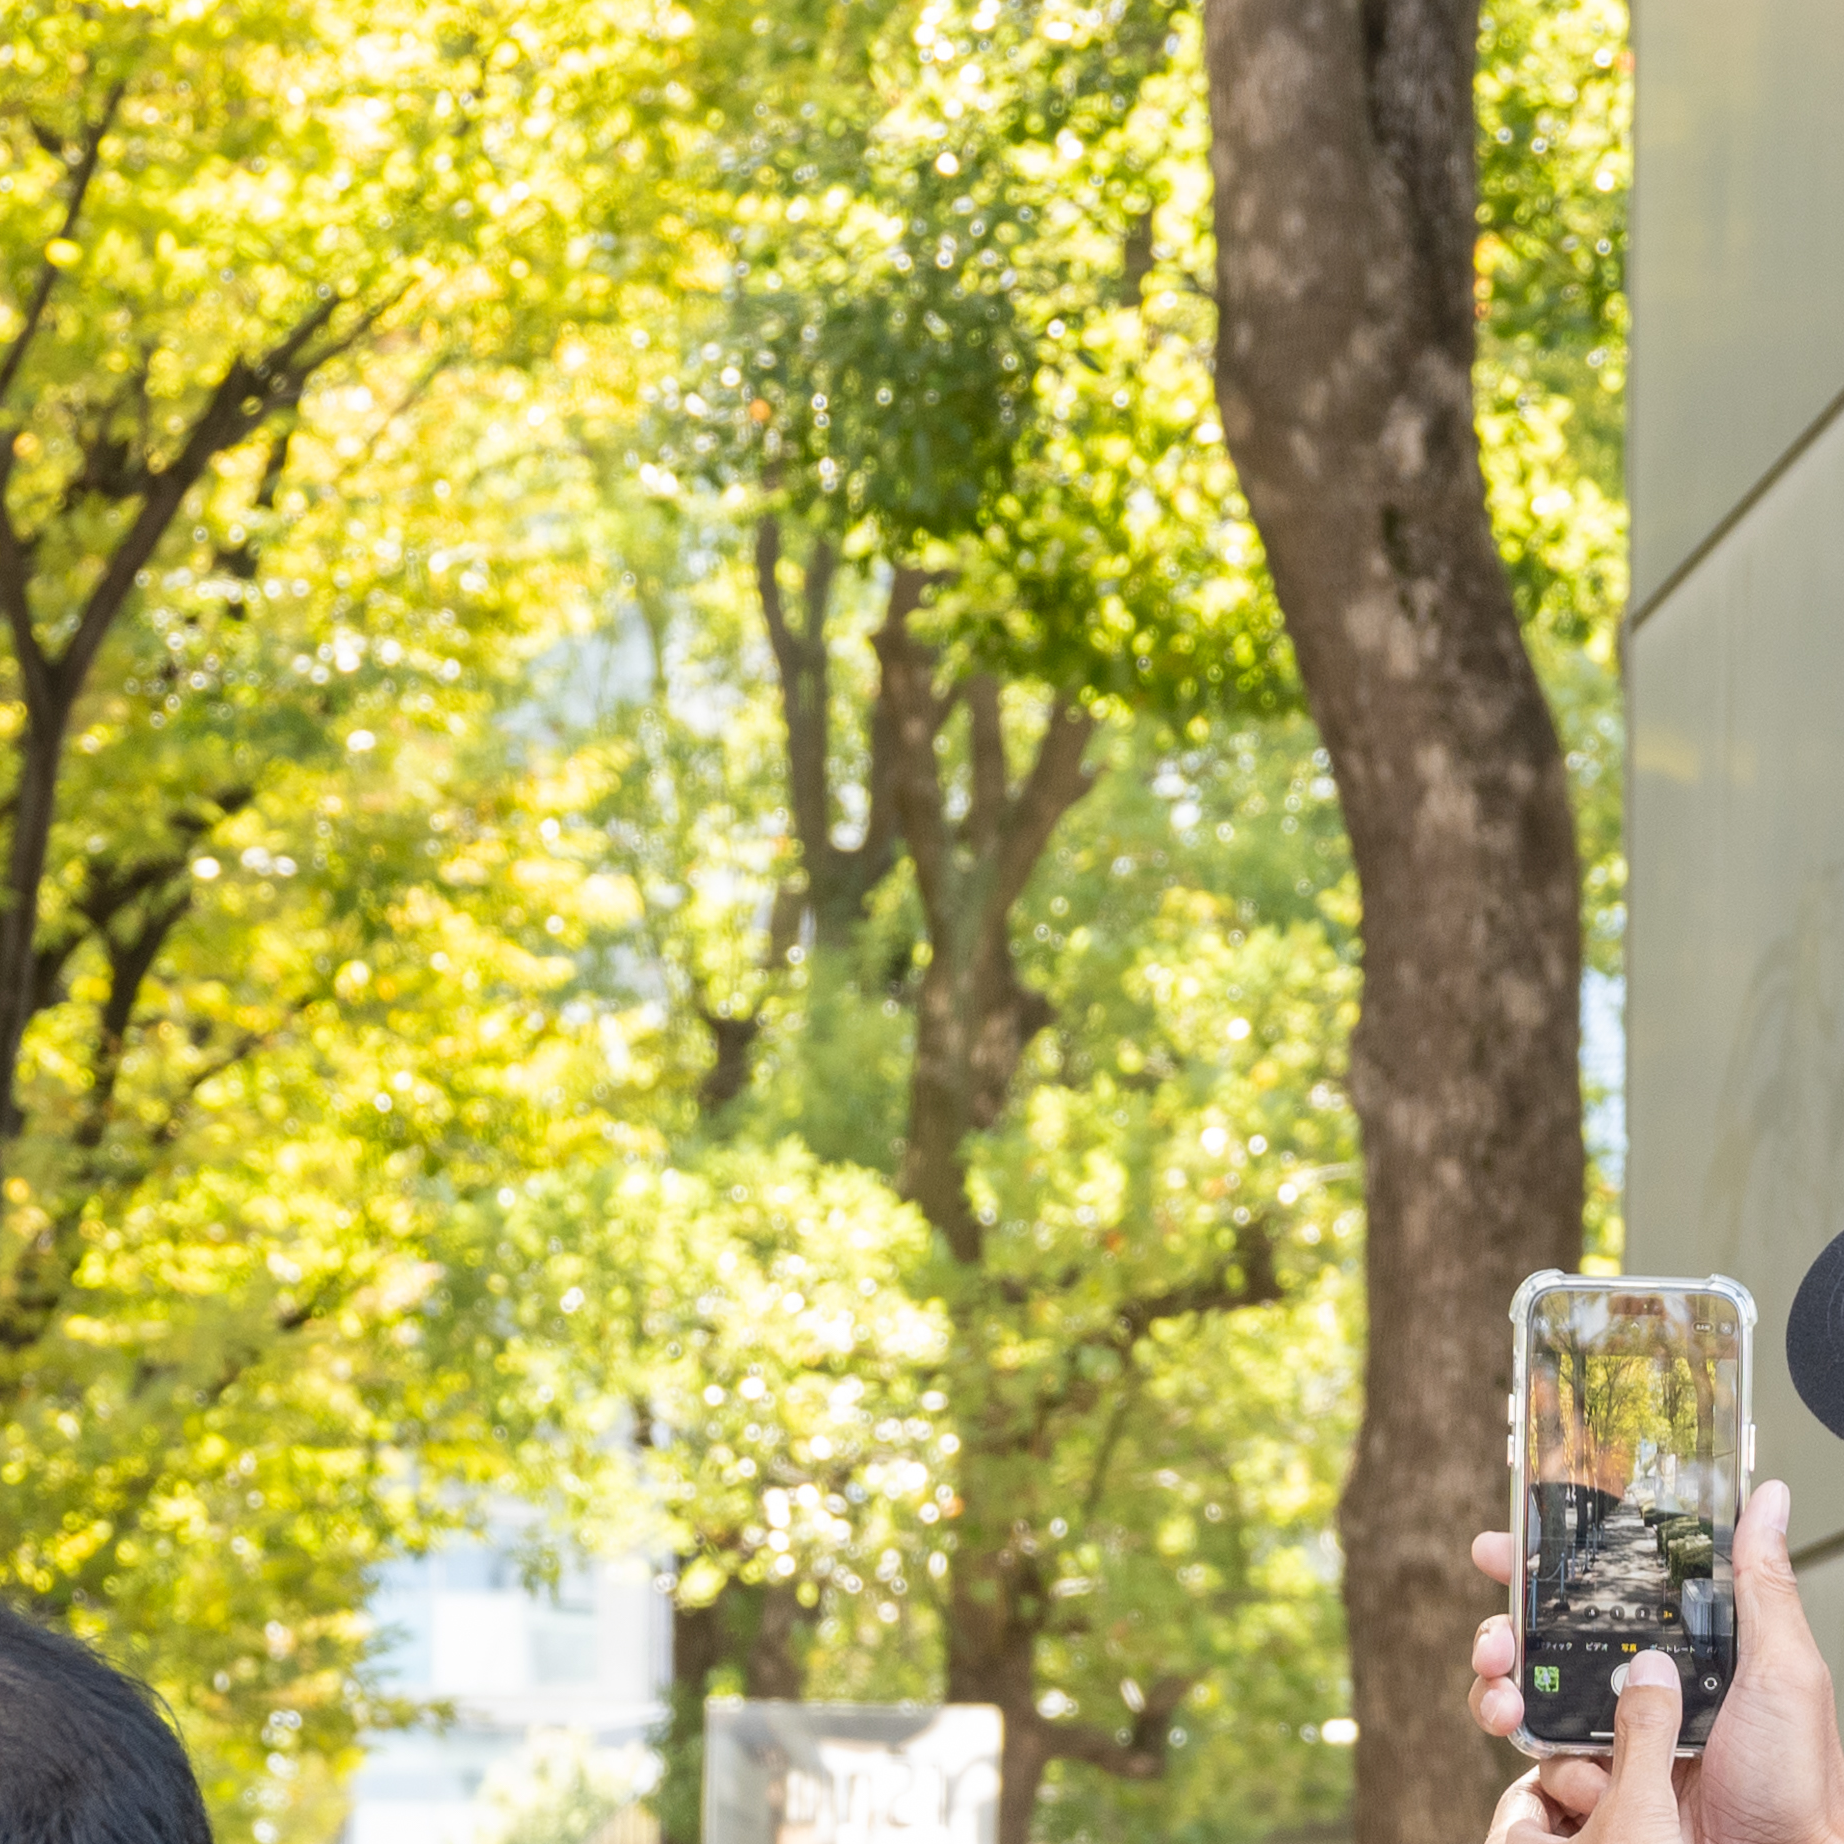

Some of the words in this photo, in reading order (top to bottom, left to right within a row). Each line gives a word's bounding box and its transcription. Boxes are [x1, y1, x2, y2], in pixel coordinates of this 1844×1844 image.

[1585, 1642, 1608, 1652] ビデオ
[1621, 1643, 1637, 1653] 写真
